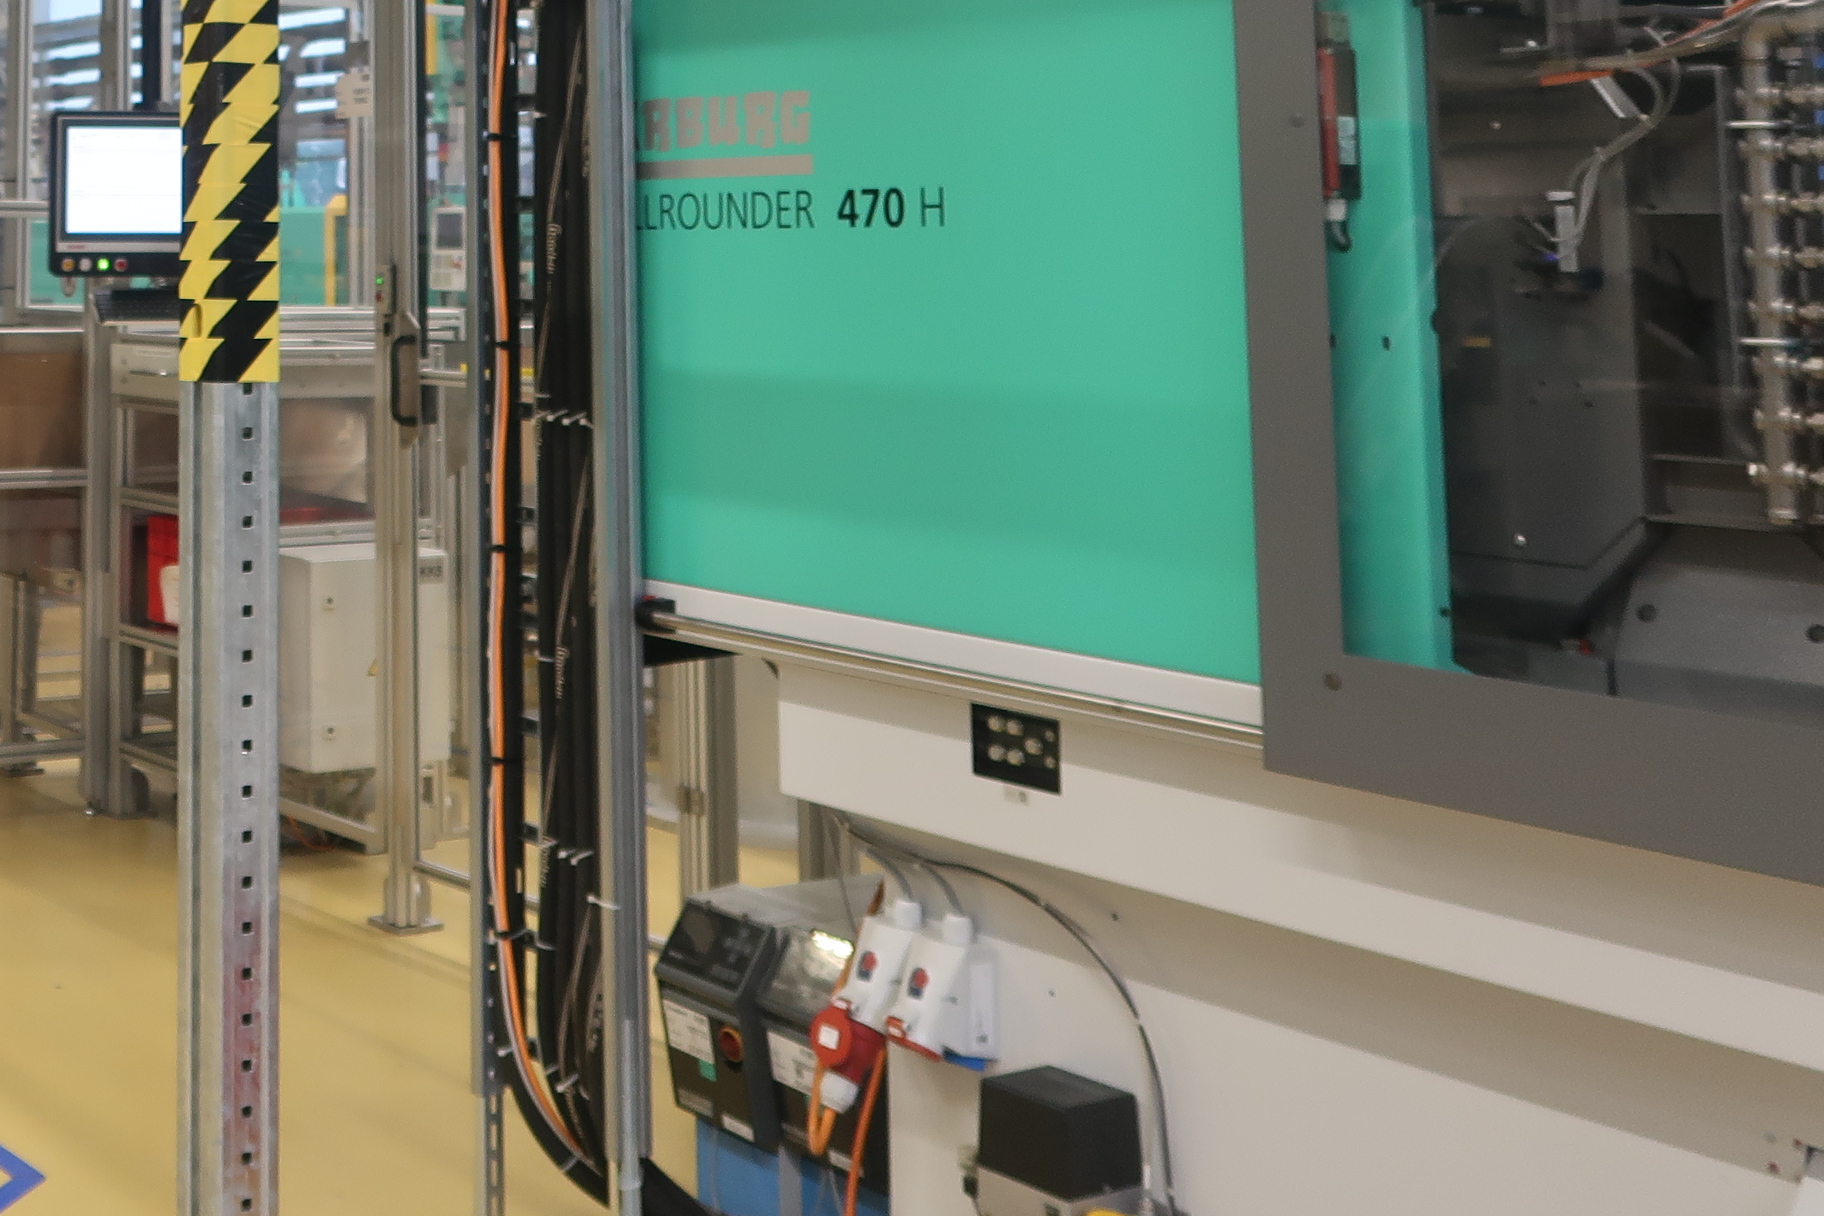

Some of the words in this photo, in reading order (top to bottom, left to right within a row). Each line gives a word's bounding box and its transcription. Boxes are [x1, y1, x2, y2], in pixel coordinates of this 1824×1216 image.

[635, 90, 811, 152] RBURG
[636, 190, 815, 230] LROUNDER
[837, 187, 905, 228] 470
[920, 186, 945, 227] H
